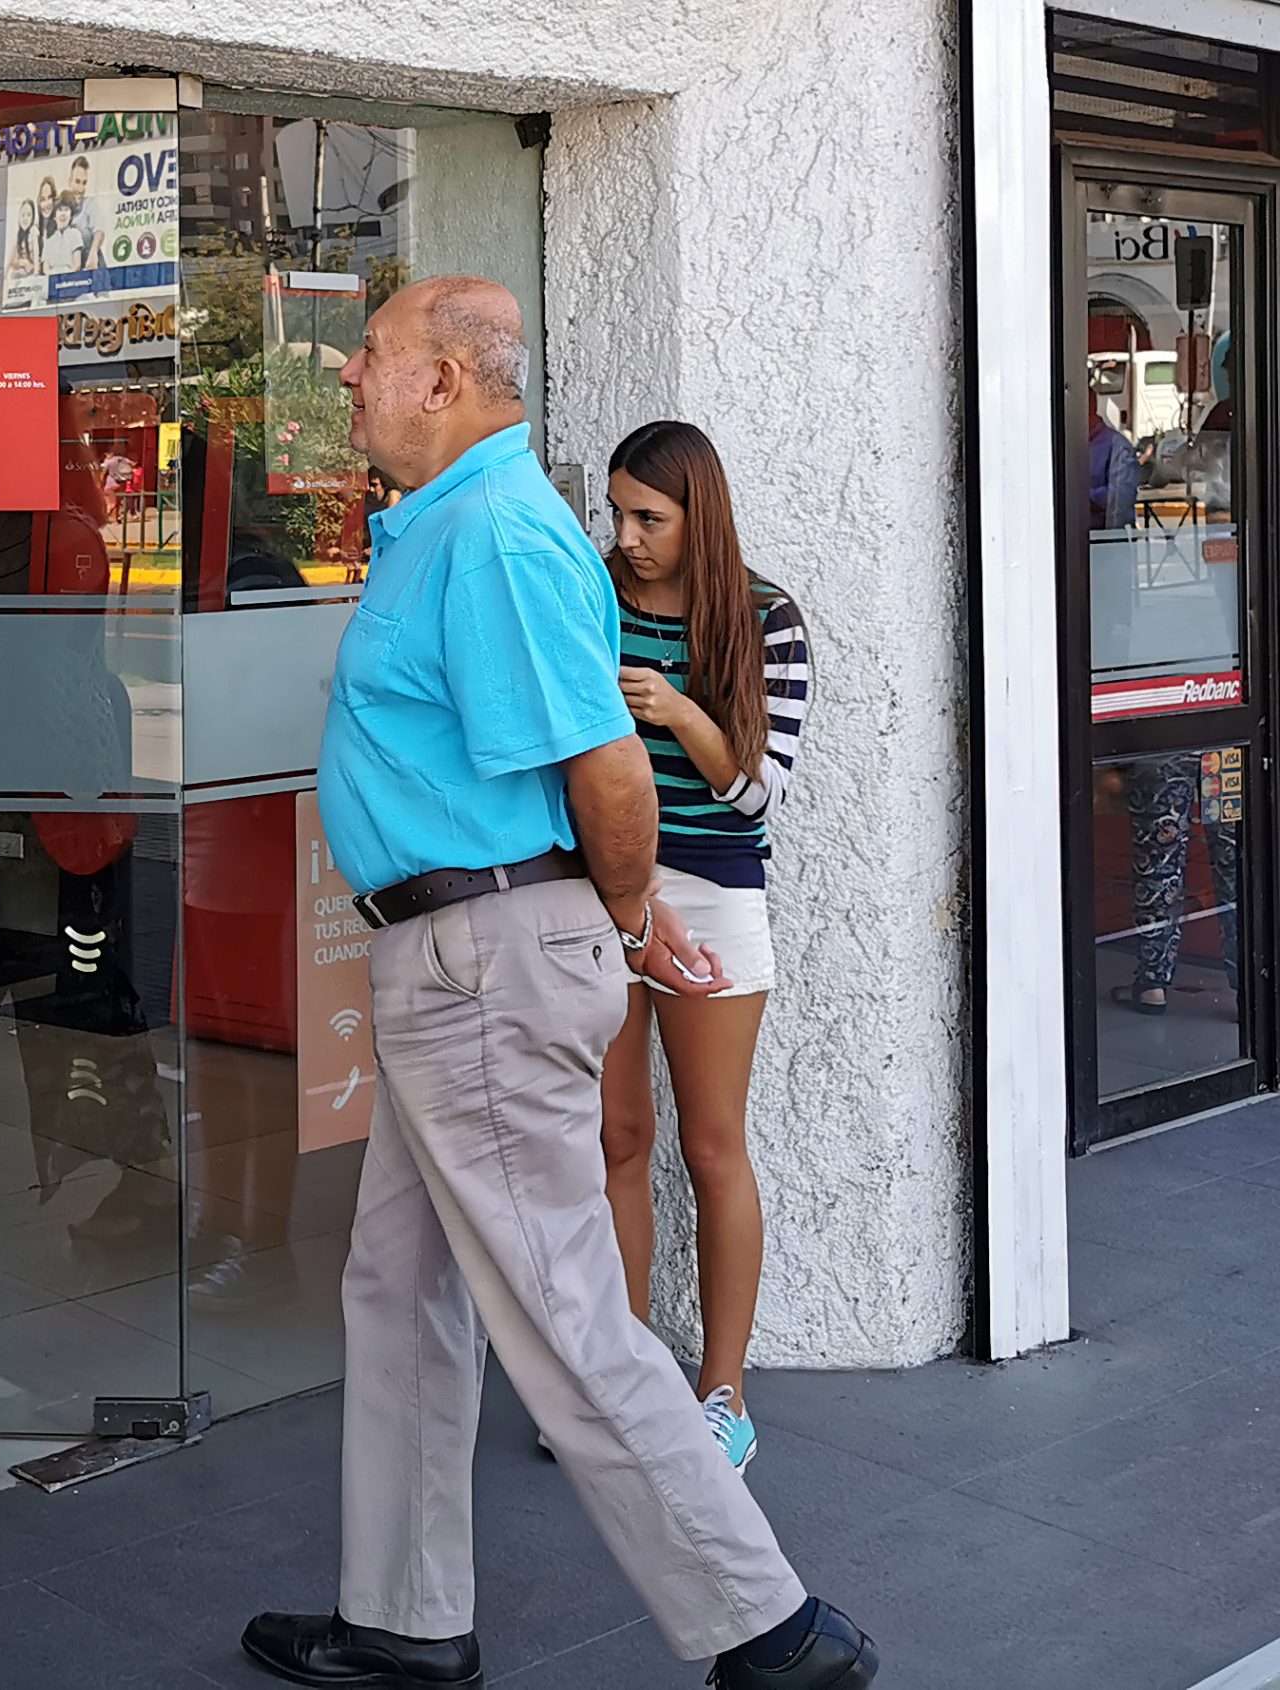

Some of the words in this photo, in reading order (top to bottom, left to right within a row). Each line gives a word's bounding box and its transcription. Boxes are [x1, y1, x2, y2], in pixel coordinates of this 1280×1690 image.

[2, 372, 31, 380] VIERNES
[1181, 678, 1241, 704] Redbanc
[1223, 752, 1240, 765] VISA
[1223, 776, 1240, 788] VISA
[314, 920, 341, 940] TUS
[343, 917, 372, 936] REC
